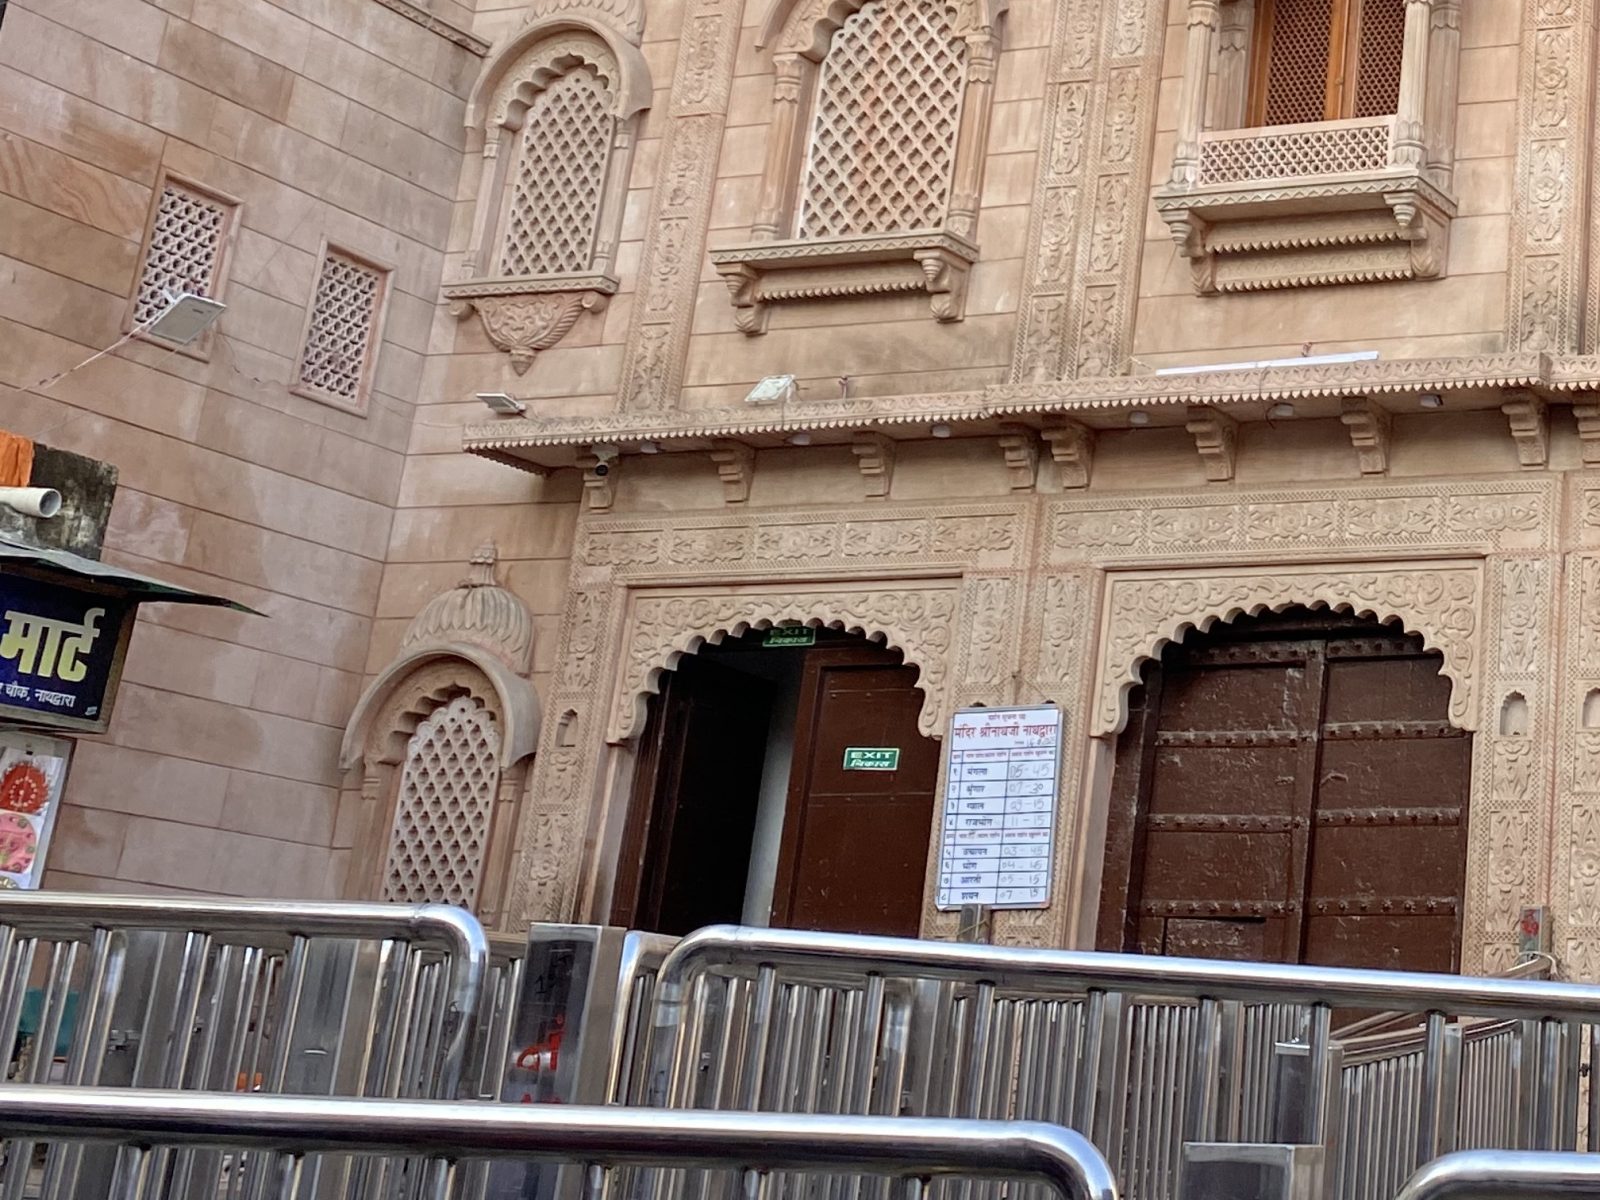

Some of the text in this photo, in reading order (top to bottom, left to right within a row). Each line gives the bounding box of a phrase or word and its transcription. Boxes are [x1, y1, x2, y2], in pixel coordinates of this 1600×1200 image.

[0, 607, 105, 682] मार्ट
[954, 723, 976, 739] मंदिर
[979, 721, 1020, 738] श्रीनाथजी
[850, 751, 893, 759] EXIT
